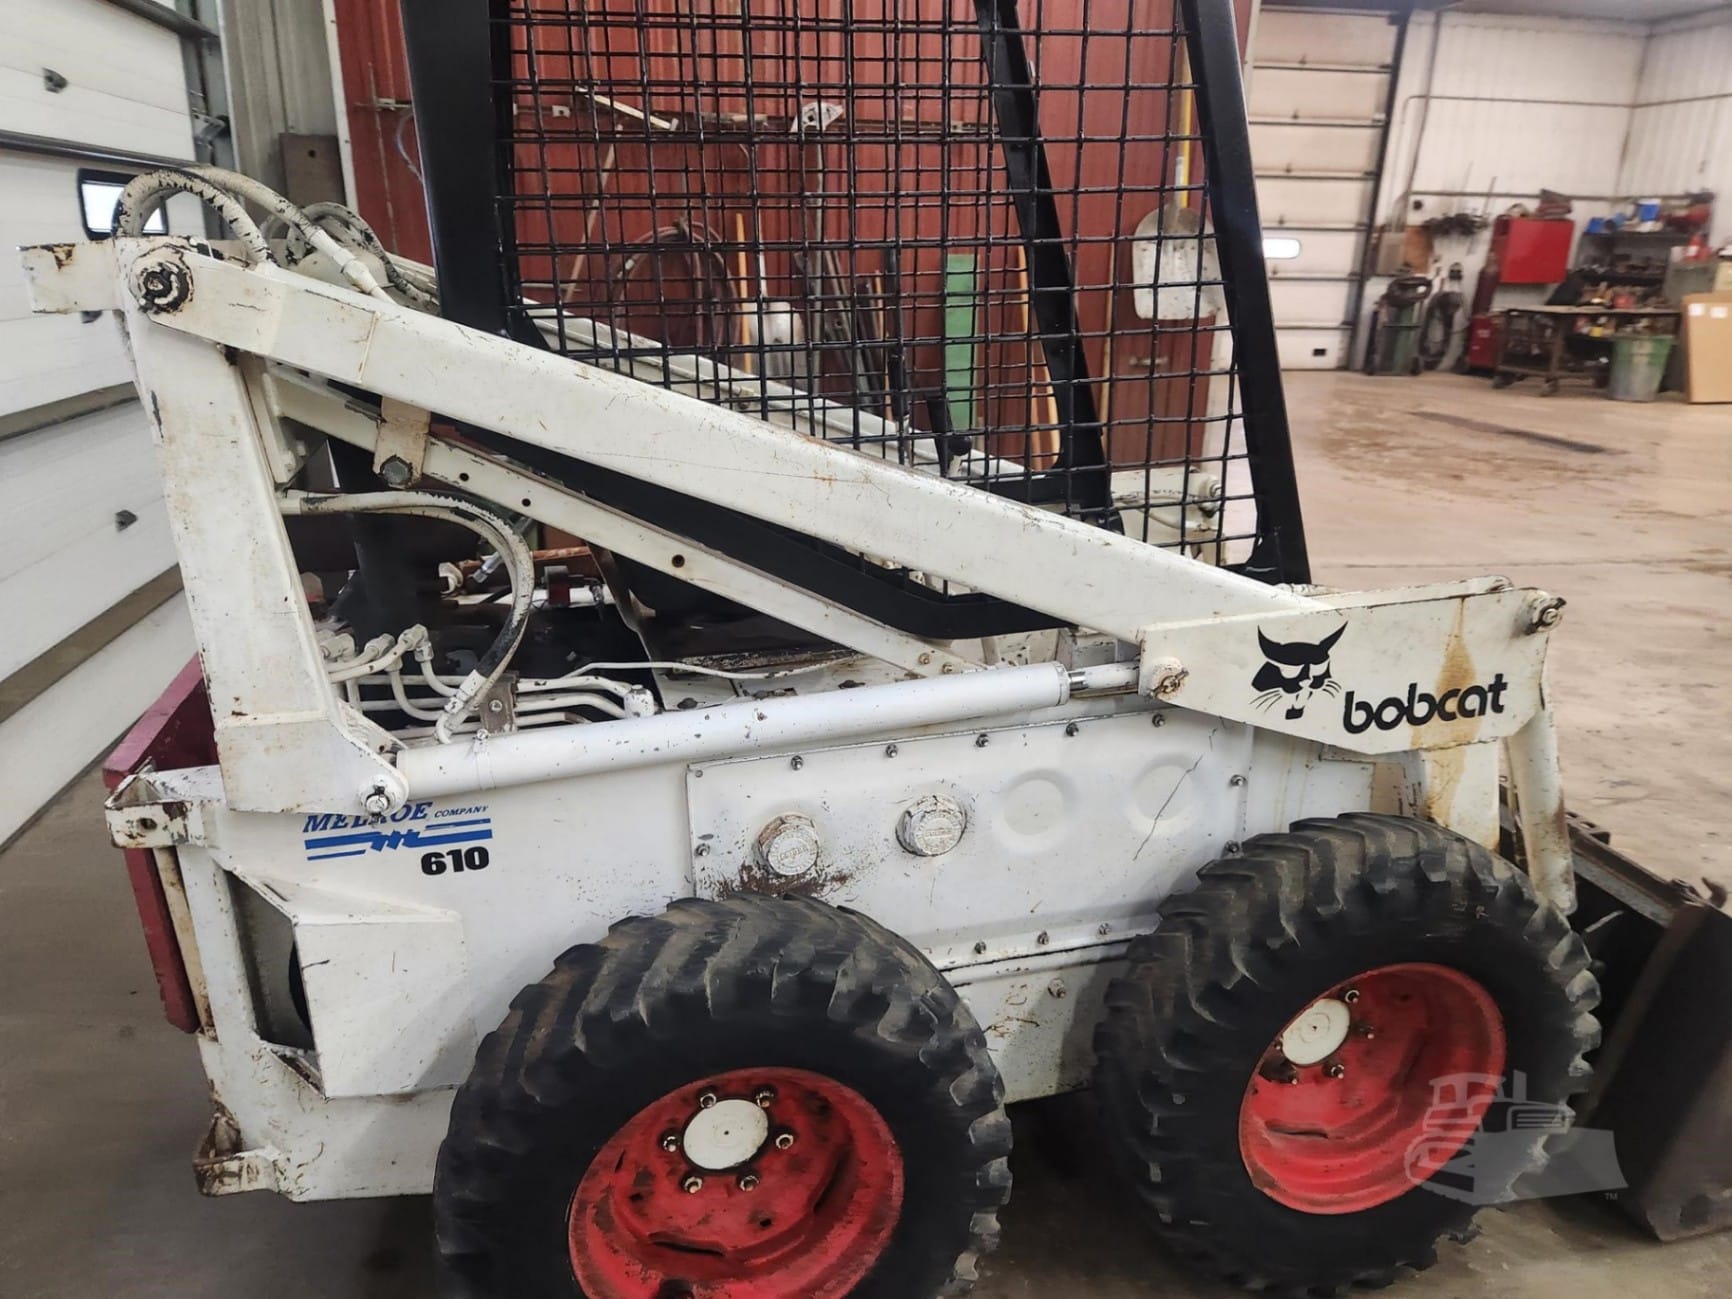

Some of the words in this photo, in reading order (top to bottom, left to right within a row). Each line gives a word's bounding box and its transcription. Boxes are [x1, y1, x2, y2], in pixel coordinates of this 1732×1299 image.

[1343, 673, 1508, 734] bobcat
[302, 801, 433, 833] MELOE
[434, 805, 489, 818] COMPANY
[421, 846, 490, 876] 610
